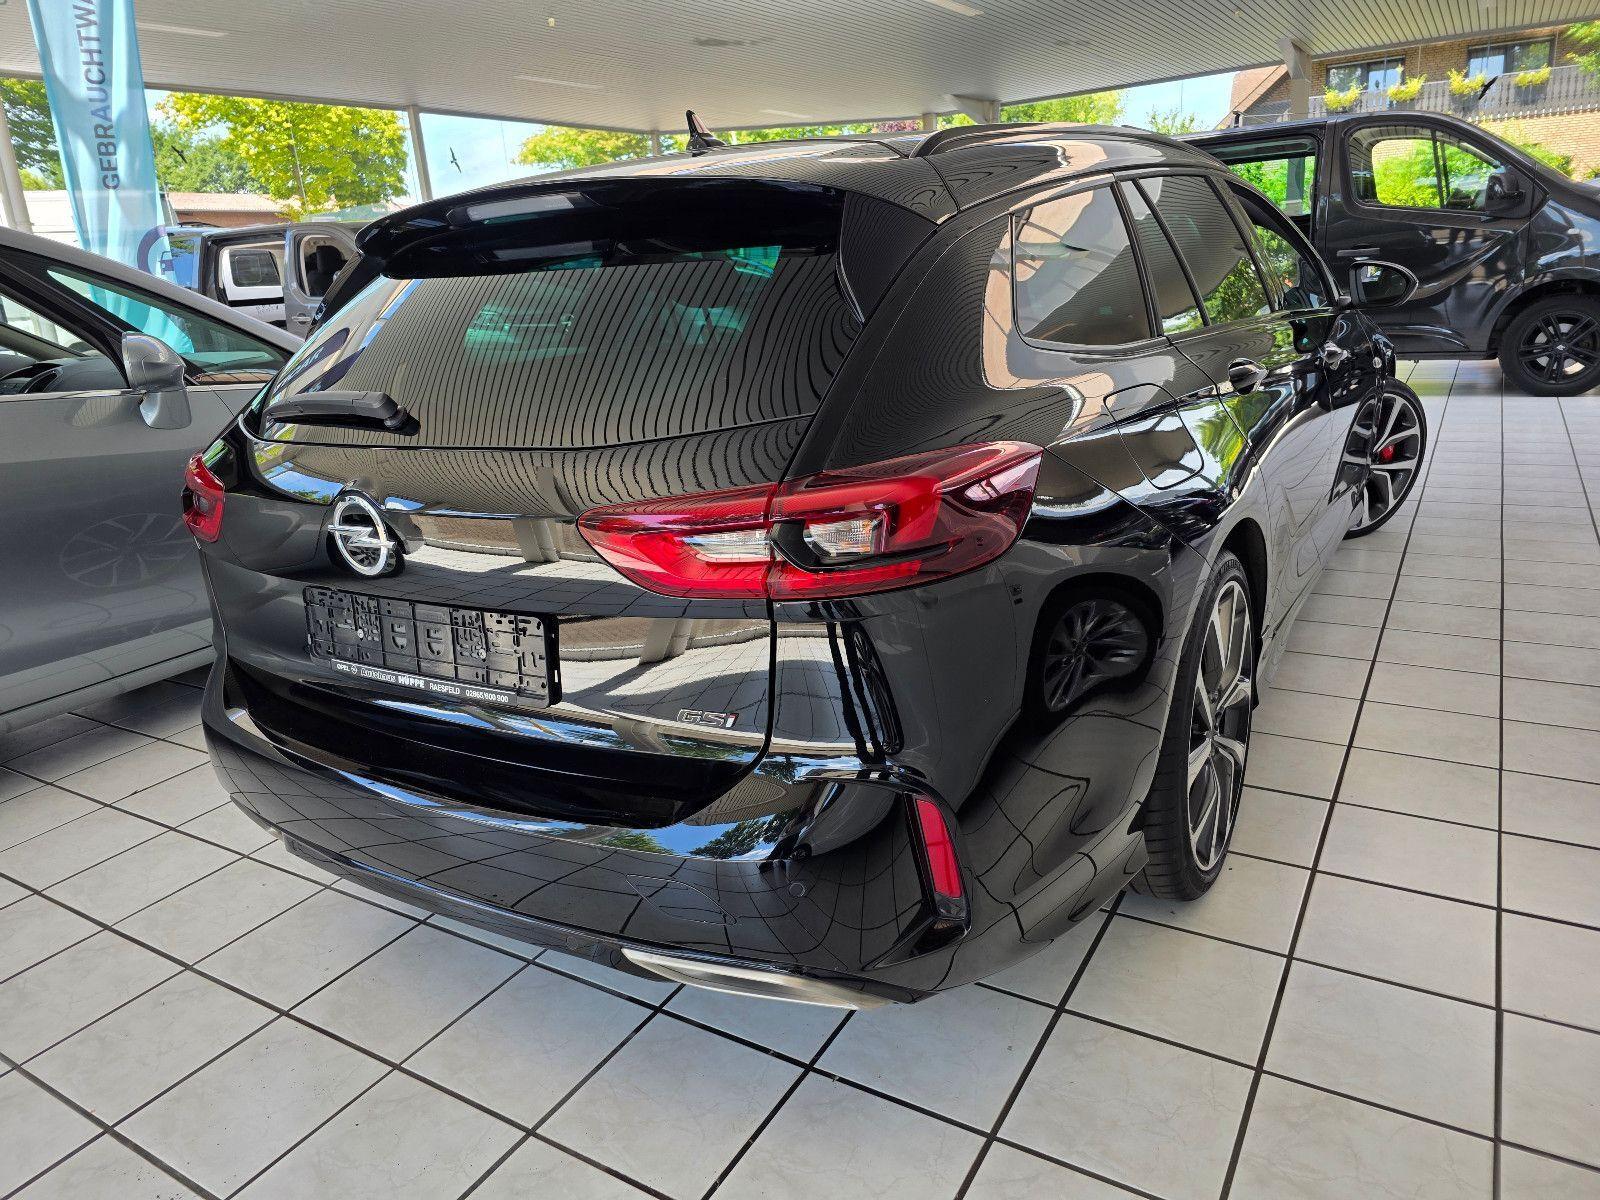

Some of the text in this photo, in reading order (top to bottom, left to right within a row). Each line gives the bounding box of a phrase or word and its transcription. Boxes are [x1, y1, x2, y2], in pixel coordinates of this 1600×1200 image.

[336, 663, 351, 672] OPEL
[360, 667, 397, 683] Autohaus
[429, 682, 461, 695] RAESFELD
